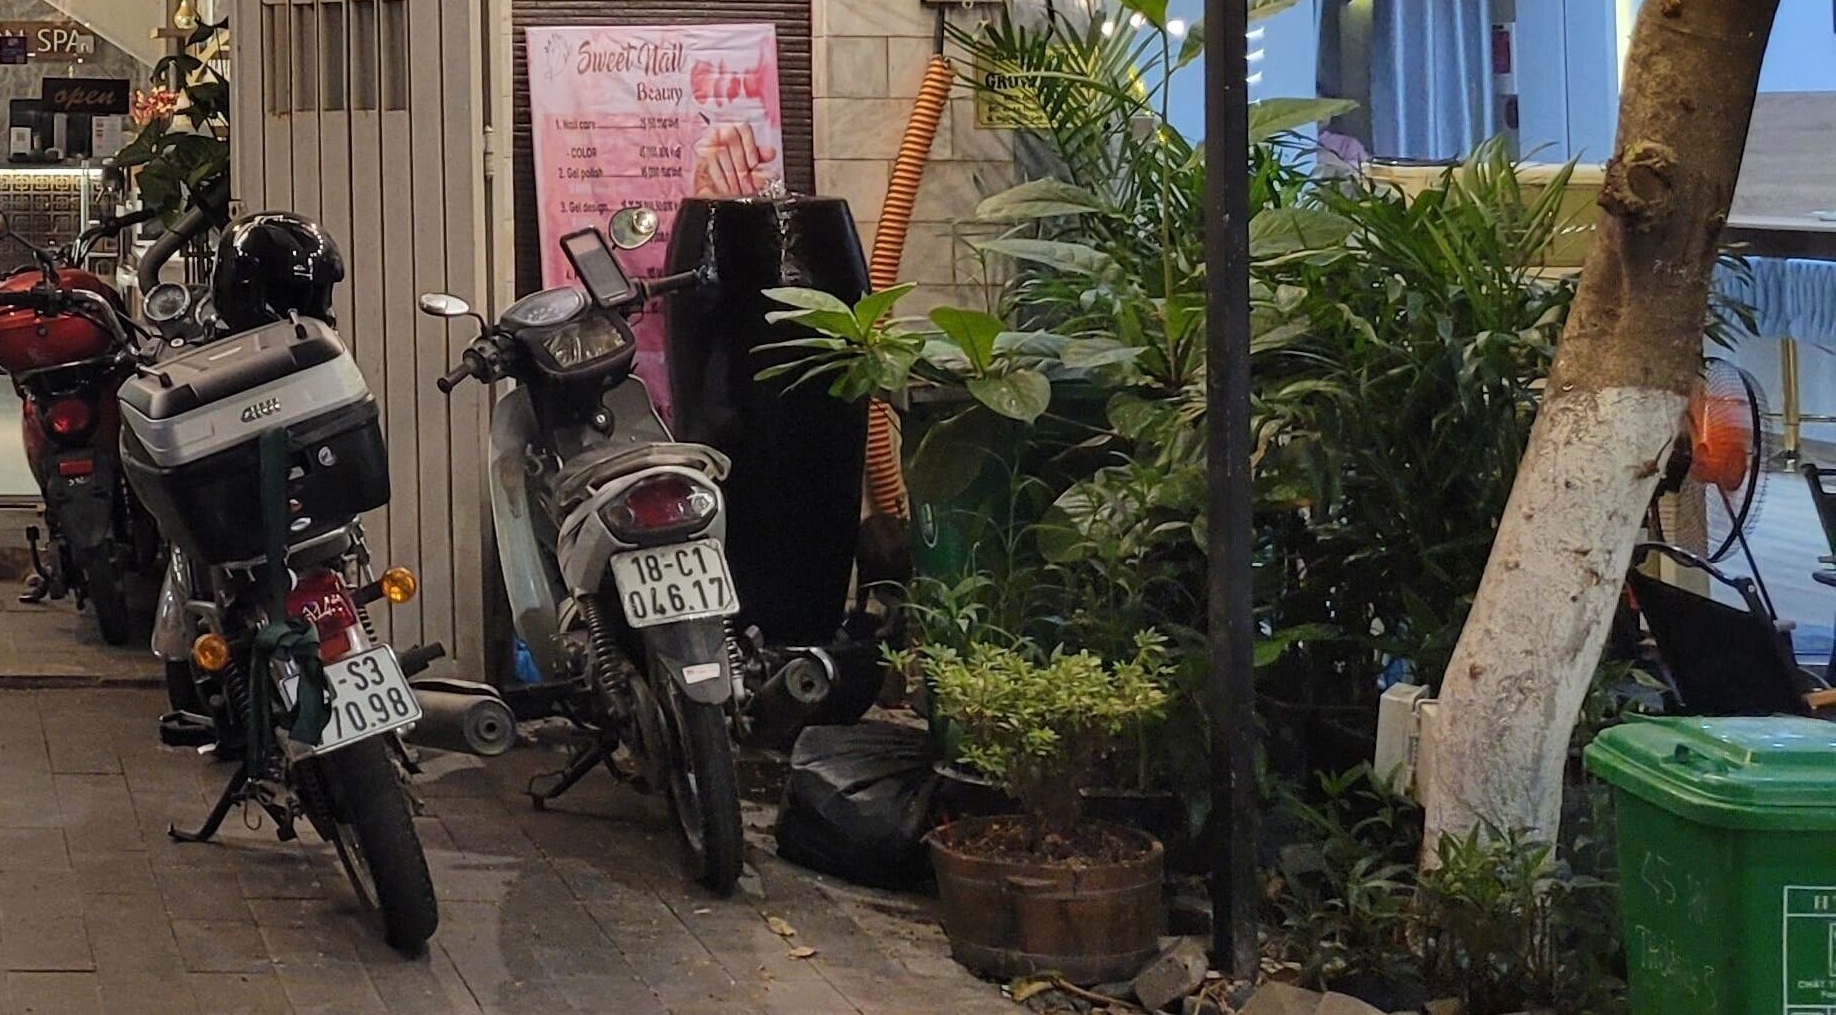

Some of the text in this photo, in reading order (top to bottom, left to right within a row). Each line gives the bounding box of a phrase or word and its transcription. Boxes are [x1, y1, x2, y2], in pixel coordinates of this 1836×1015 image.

[577, 40, 684, 76] Sweet Nail
[53, 86, 116, 110] open
[637, 81, 684, 106] Beauty
[631, 547, 708, 585] 18-C1
[629, 577, 725, 619] 046.17
